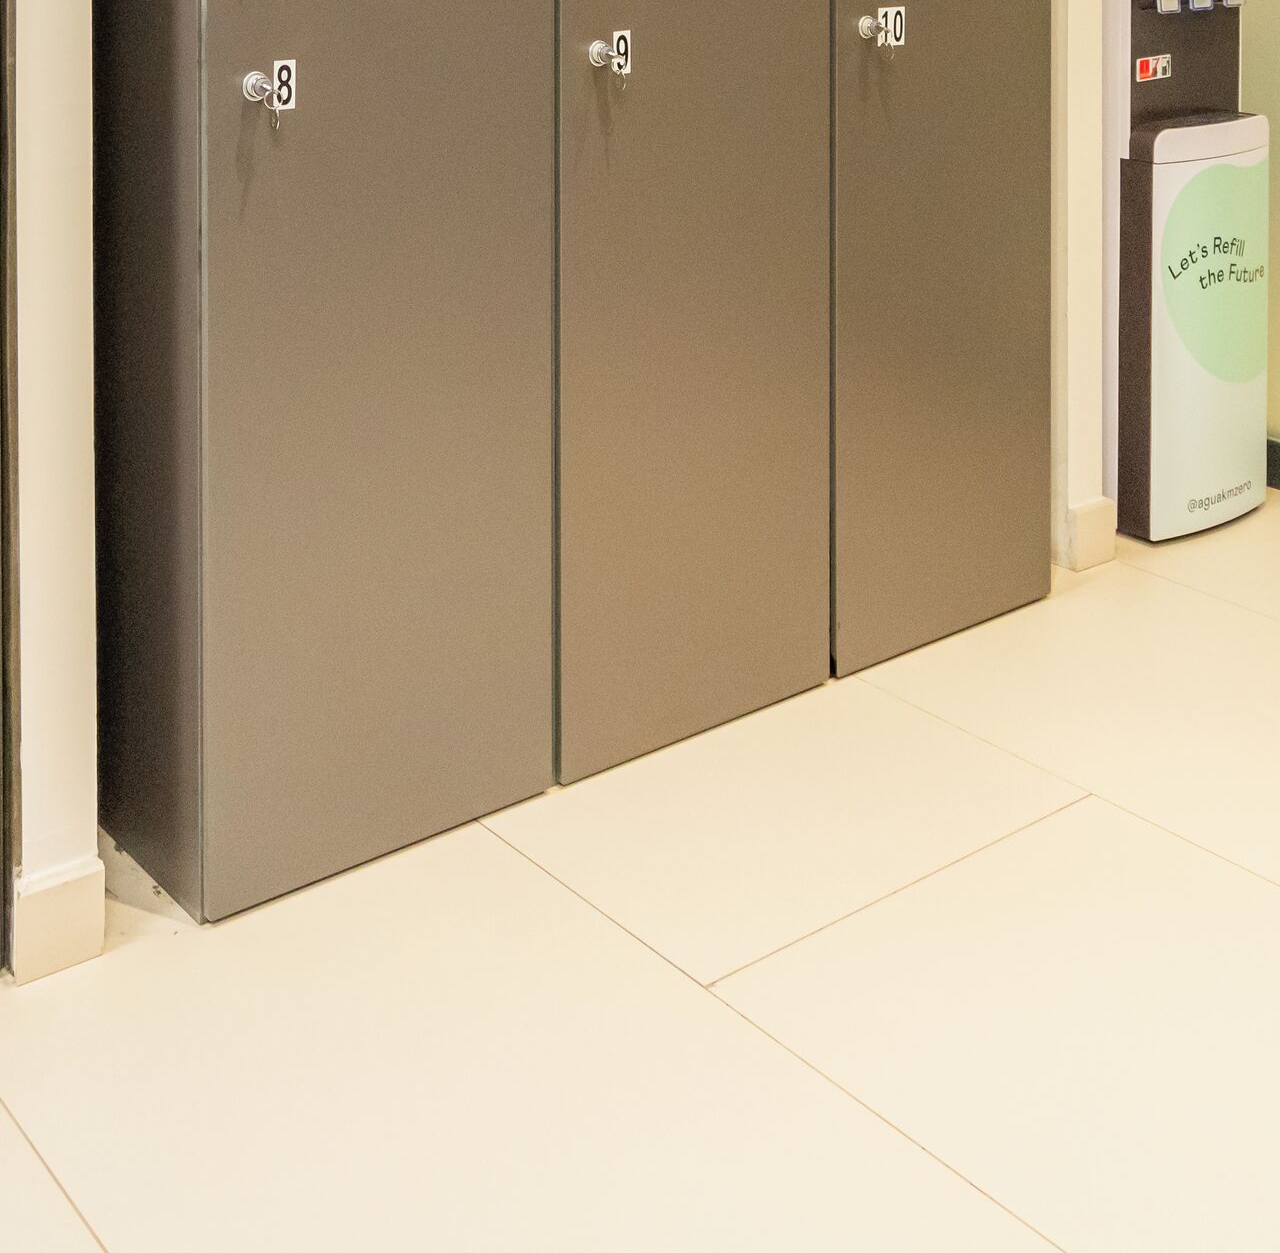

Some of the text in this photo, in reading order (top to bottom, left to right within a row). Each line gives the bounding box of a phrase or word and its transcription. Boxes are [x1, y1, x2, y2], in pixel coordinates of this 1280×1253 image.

[881, 10, 904, 44] 10
[616, 34, 629, 70] 9
[277, 64, 292, 106] 8
[1168, 236, 1245, 280] Let's Refill
[1199, 263, 1265, 289] the Future
